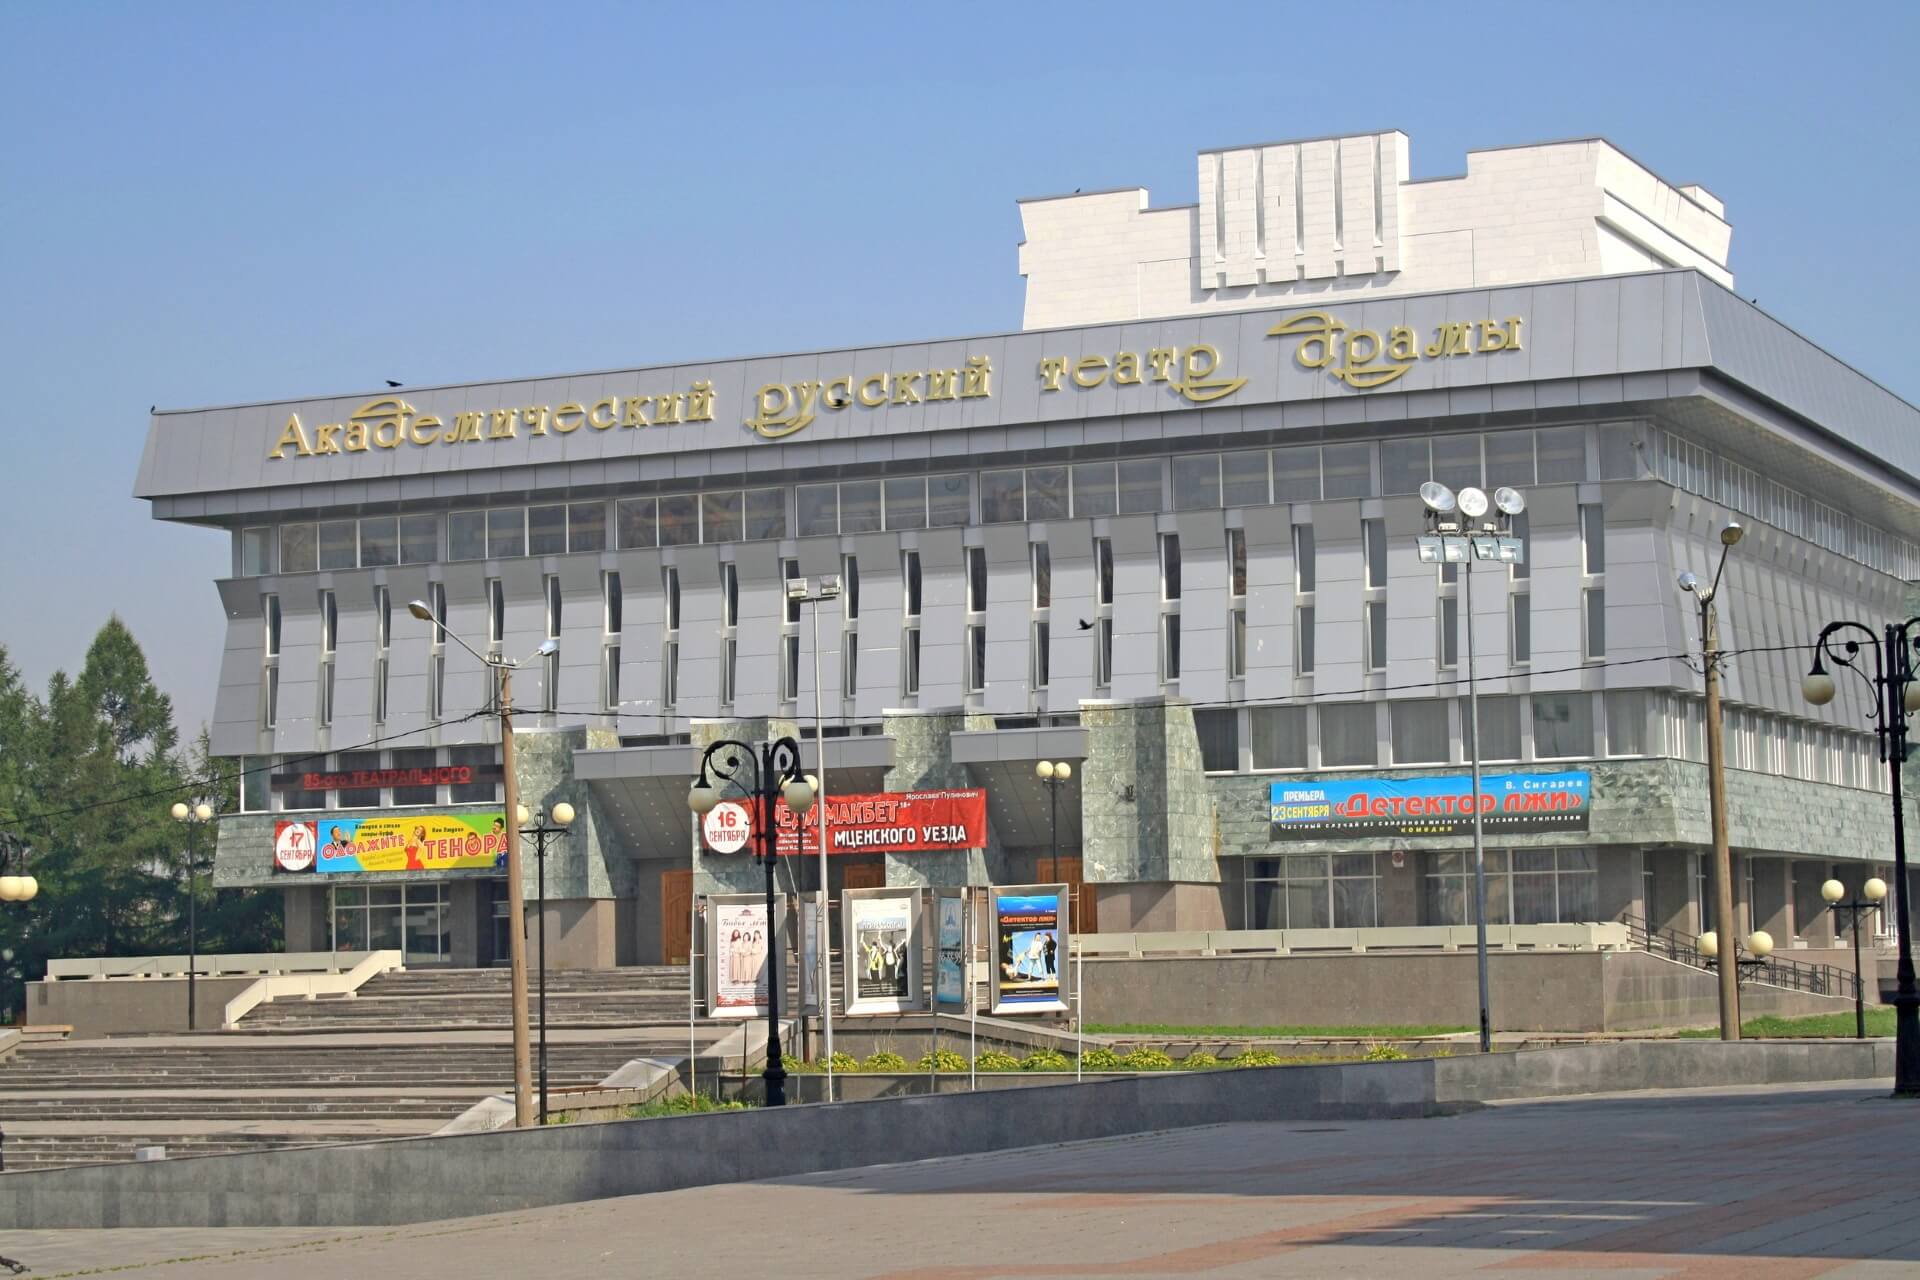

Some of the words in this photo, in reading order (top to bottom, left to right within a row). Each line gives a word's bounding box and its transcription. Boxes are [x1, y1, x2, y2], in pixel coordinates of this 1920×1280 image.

[269, 381, 717, 459] Академический
[744, 355, 992, 438] русский
[1039, 342, 1248, 401] театр
[1266, 310, 1524, 388] драмы
[351, 766, 472, 786] ТЕАТРАЛЬНОГО
[1505, 781, 1516, 790] В.
[1283, 790, 1325, 801] ПРЕМЬЕРА
[824, 800, 899, 826] МАКБЕТ
[1272, 806, 1286, 821] 23
[1286, 804, 1330, 819] СЕНТЯБРЯ
[1334, 793, 1497, 818] «Детектор
[718, 811, 737, 828] 16
[1470, 816, 1519, 825] кусами
[289, 831, 304, 848] 17
[709, 830, 746, 843] СЕНТЯБРЯ
[834, 827, 916, 849] МЦЕНСКОГО
[922, 825, 967, 844] УЕЗДА
[322, 834, 405, 859] ОДОЛЖИТЕ
[424, 832, 508, 860] ТЕНОРА
